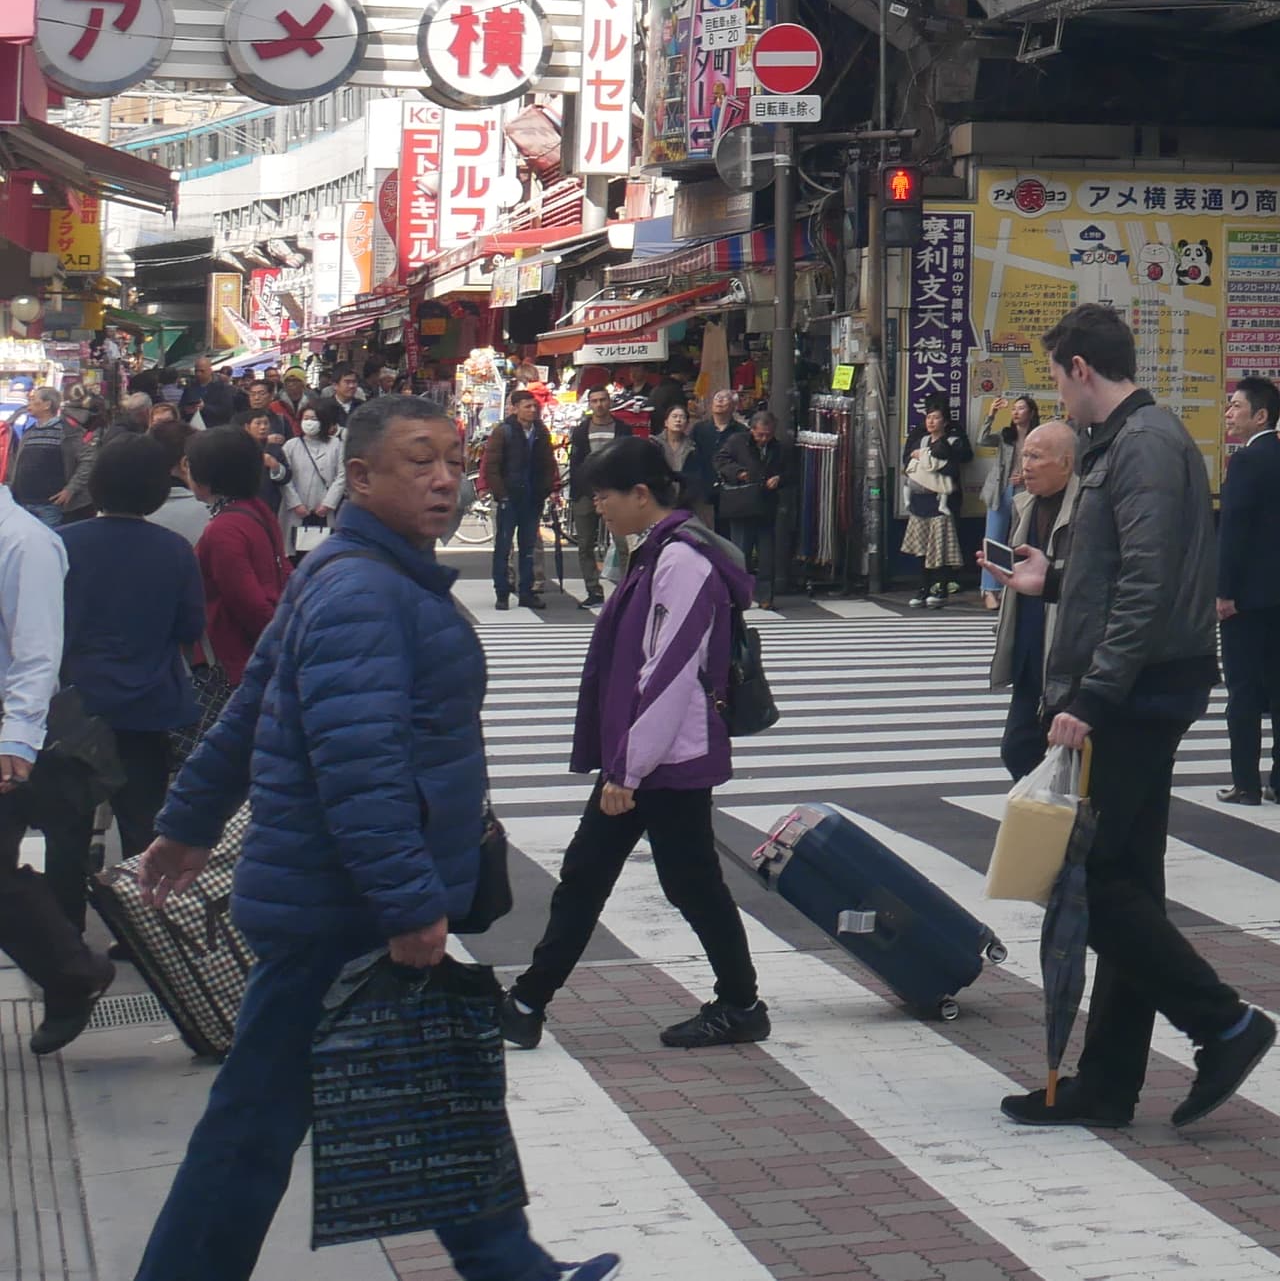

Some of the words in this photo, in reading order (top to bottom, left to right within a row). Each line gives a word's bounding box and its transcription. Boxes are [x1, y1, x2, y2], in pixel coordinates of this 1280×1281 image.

[705, 15, 741, 31] 自転車を除く
[755, 102, 815, 118] 自転車を除く
[64, 254, 90, 265] 入口
[914, 216, 950, 329] 摩利支天
[595, 346, 648, 356] マルセル店
